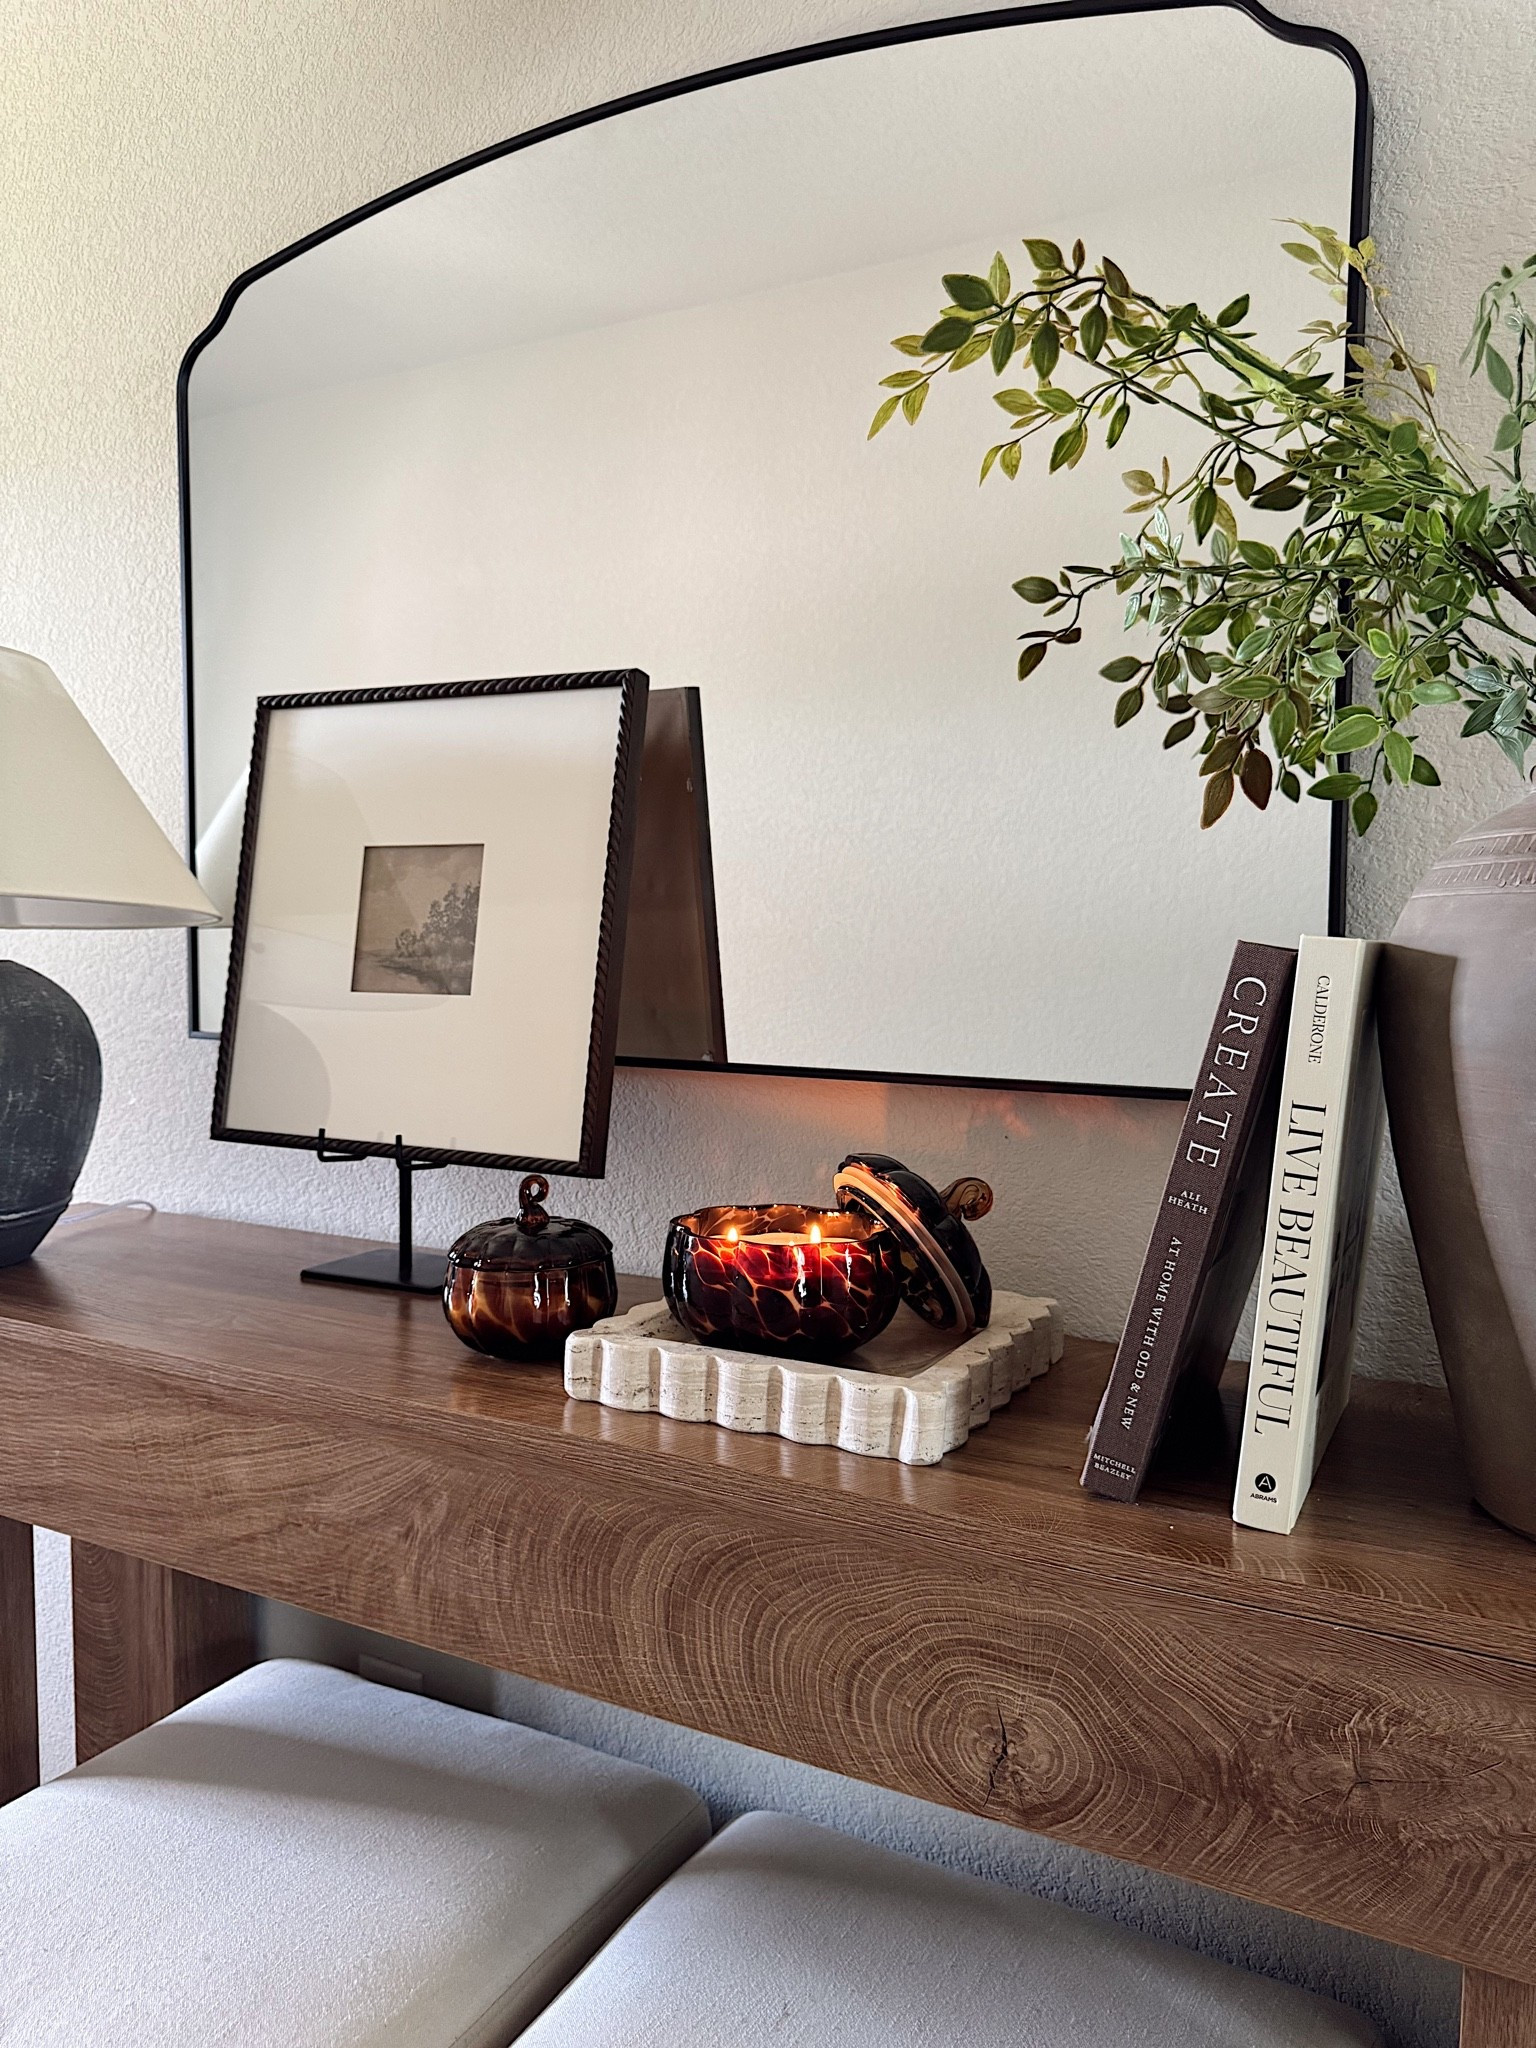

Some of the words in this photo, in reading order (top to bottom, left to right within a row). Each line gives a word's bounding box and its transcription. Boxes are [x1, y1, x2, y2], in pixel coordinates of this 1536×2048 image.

[1308, 975, 1331, 1064] CALDERONE
[1185, 976, 1267, 1168] CREATE
[1282, 1100, 1327, 1197] LIVE
[1167, 1195, 1208, 1215] HEATH
[1180, 1190, 1201, 1202] ALI
[1169, 1236, 1183, 1258] AT
[1155, 1260, 1175, 1302] HOME
[1140, 1306, 1164, 1346] WITH
[1254, 1204, 1315, 1435] BEAUTIFUL
[1134, 1350, 1151, 1379] OLD
[1130, 1381, 1141, 1393] &
[1120, 1396, 1138, 1430] NEW
[1093, 1453, 1136, 1475] MITCHELL
[1094, 1462, 1132, 1480] BEAZLEY
[1250, 1492, 1278, 1504] ABRAMS
